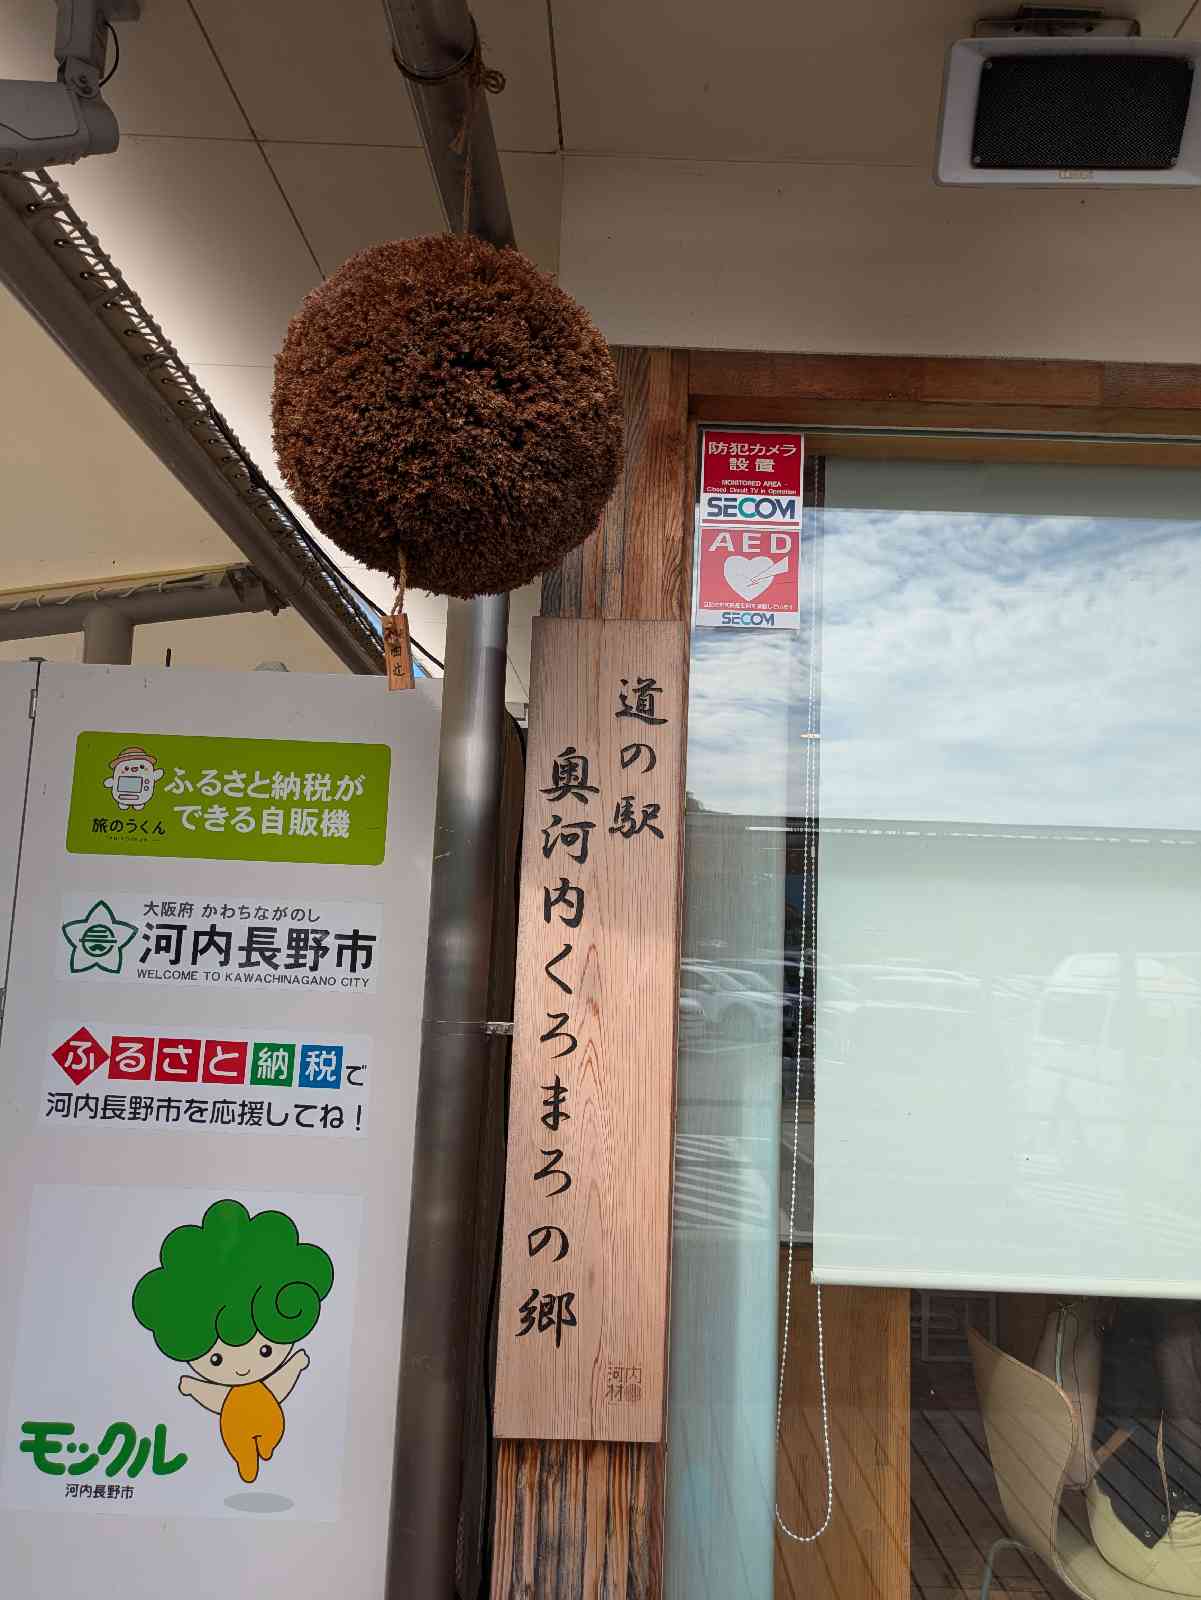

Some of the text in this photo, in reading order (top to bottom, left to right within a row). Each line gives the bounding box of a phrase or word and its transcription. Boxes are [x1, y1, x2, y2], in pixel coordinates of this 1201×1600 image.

[708, 441, 797, 456] 防犯カメラ
[729, 457, 775, 473] 設置
[707, 496, 796, 519] SECOM
[708, 532, 792, 554] AED
[721, 612, 775, 626] SECOM
[608, 677, 668, 840] 道の駅
[164, 767, 367, 803] ふるさと納税が
[92, 818, 166, 835] 旅のうくん
[173, 804, 351, 839] できる自販機
[144, 901, 320, 922] 大阪府 かわちながのし
[139, 922, 377, 973] 河内長野市
[137, 969, 370, 988] WELCOME TO KAWACHINAGANO CITY
[515, 746, 600, 1349] 奥河内くろまろの郷
[19, 1421, 188, 1478] モックル
[65, 1483, 135, 1500] 河内長野市
